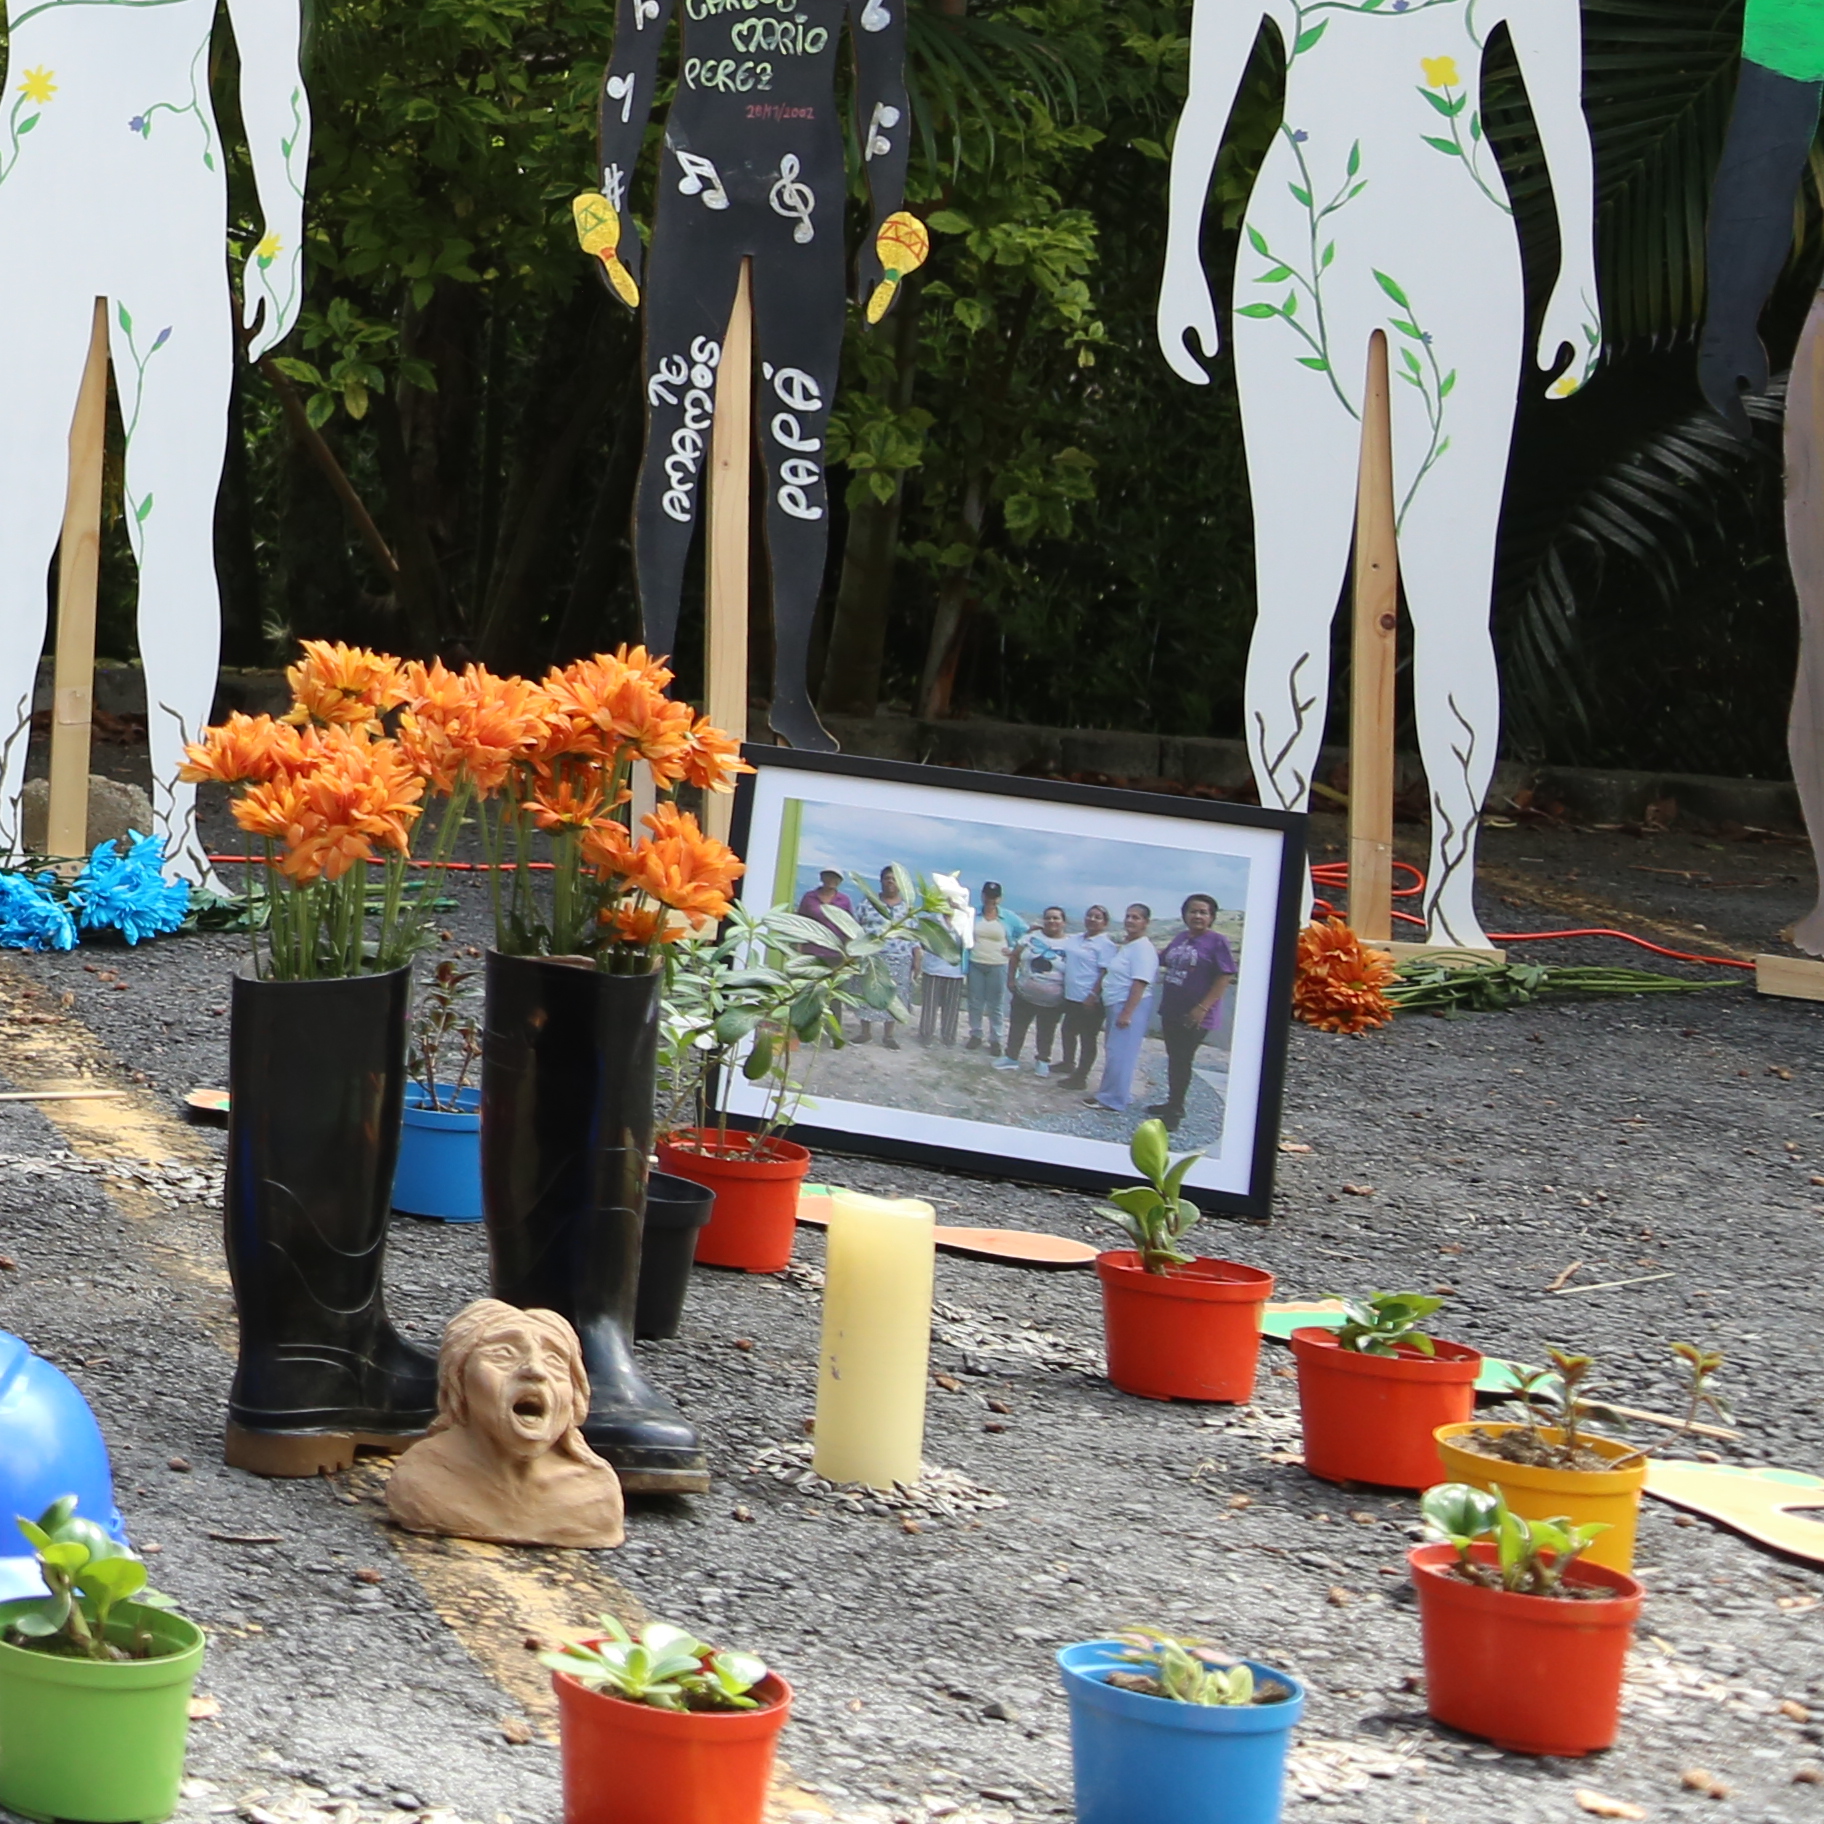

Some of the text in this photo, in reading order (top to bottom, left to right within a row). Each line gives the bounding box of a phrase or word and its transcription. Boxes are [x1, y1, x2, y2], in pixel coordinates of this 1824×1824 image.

[730, 12, 829, 57] MARIO
[684, 57, 774, 93] PEREZ
[648, 353, 690, 408] TE
[661, 334, 722, 523] AMAMOS
